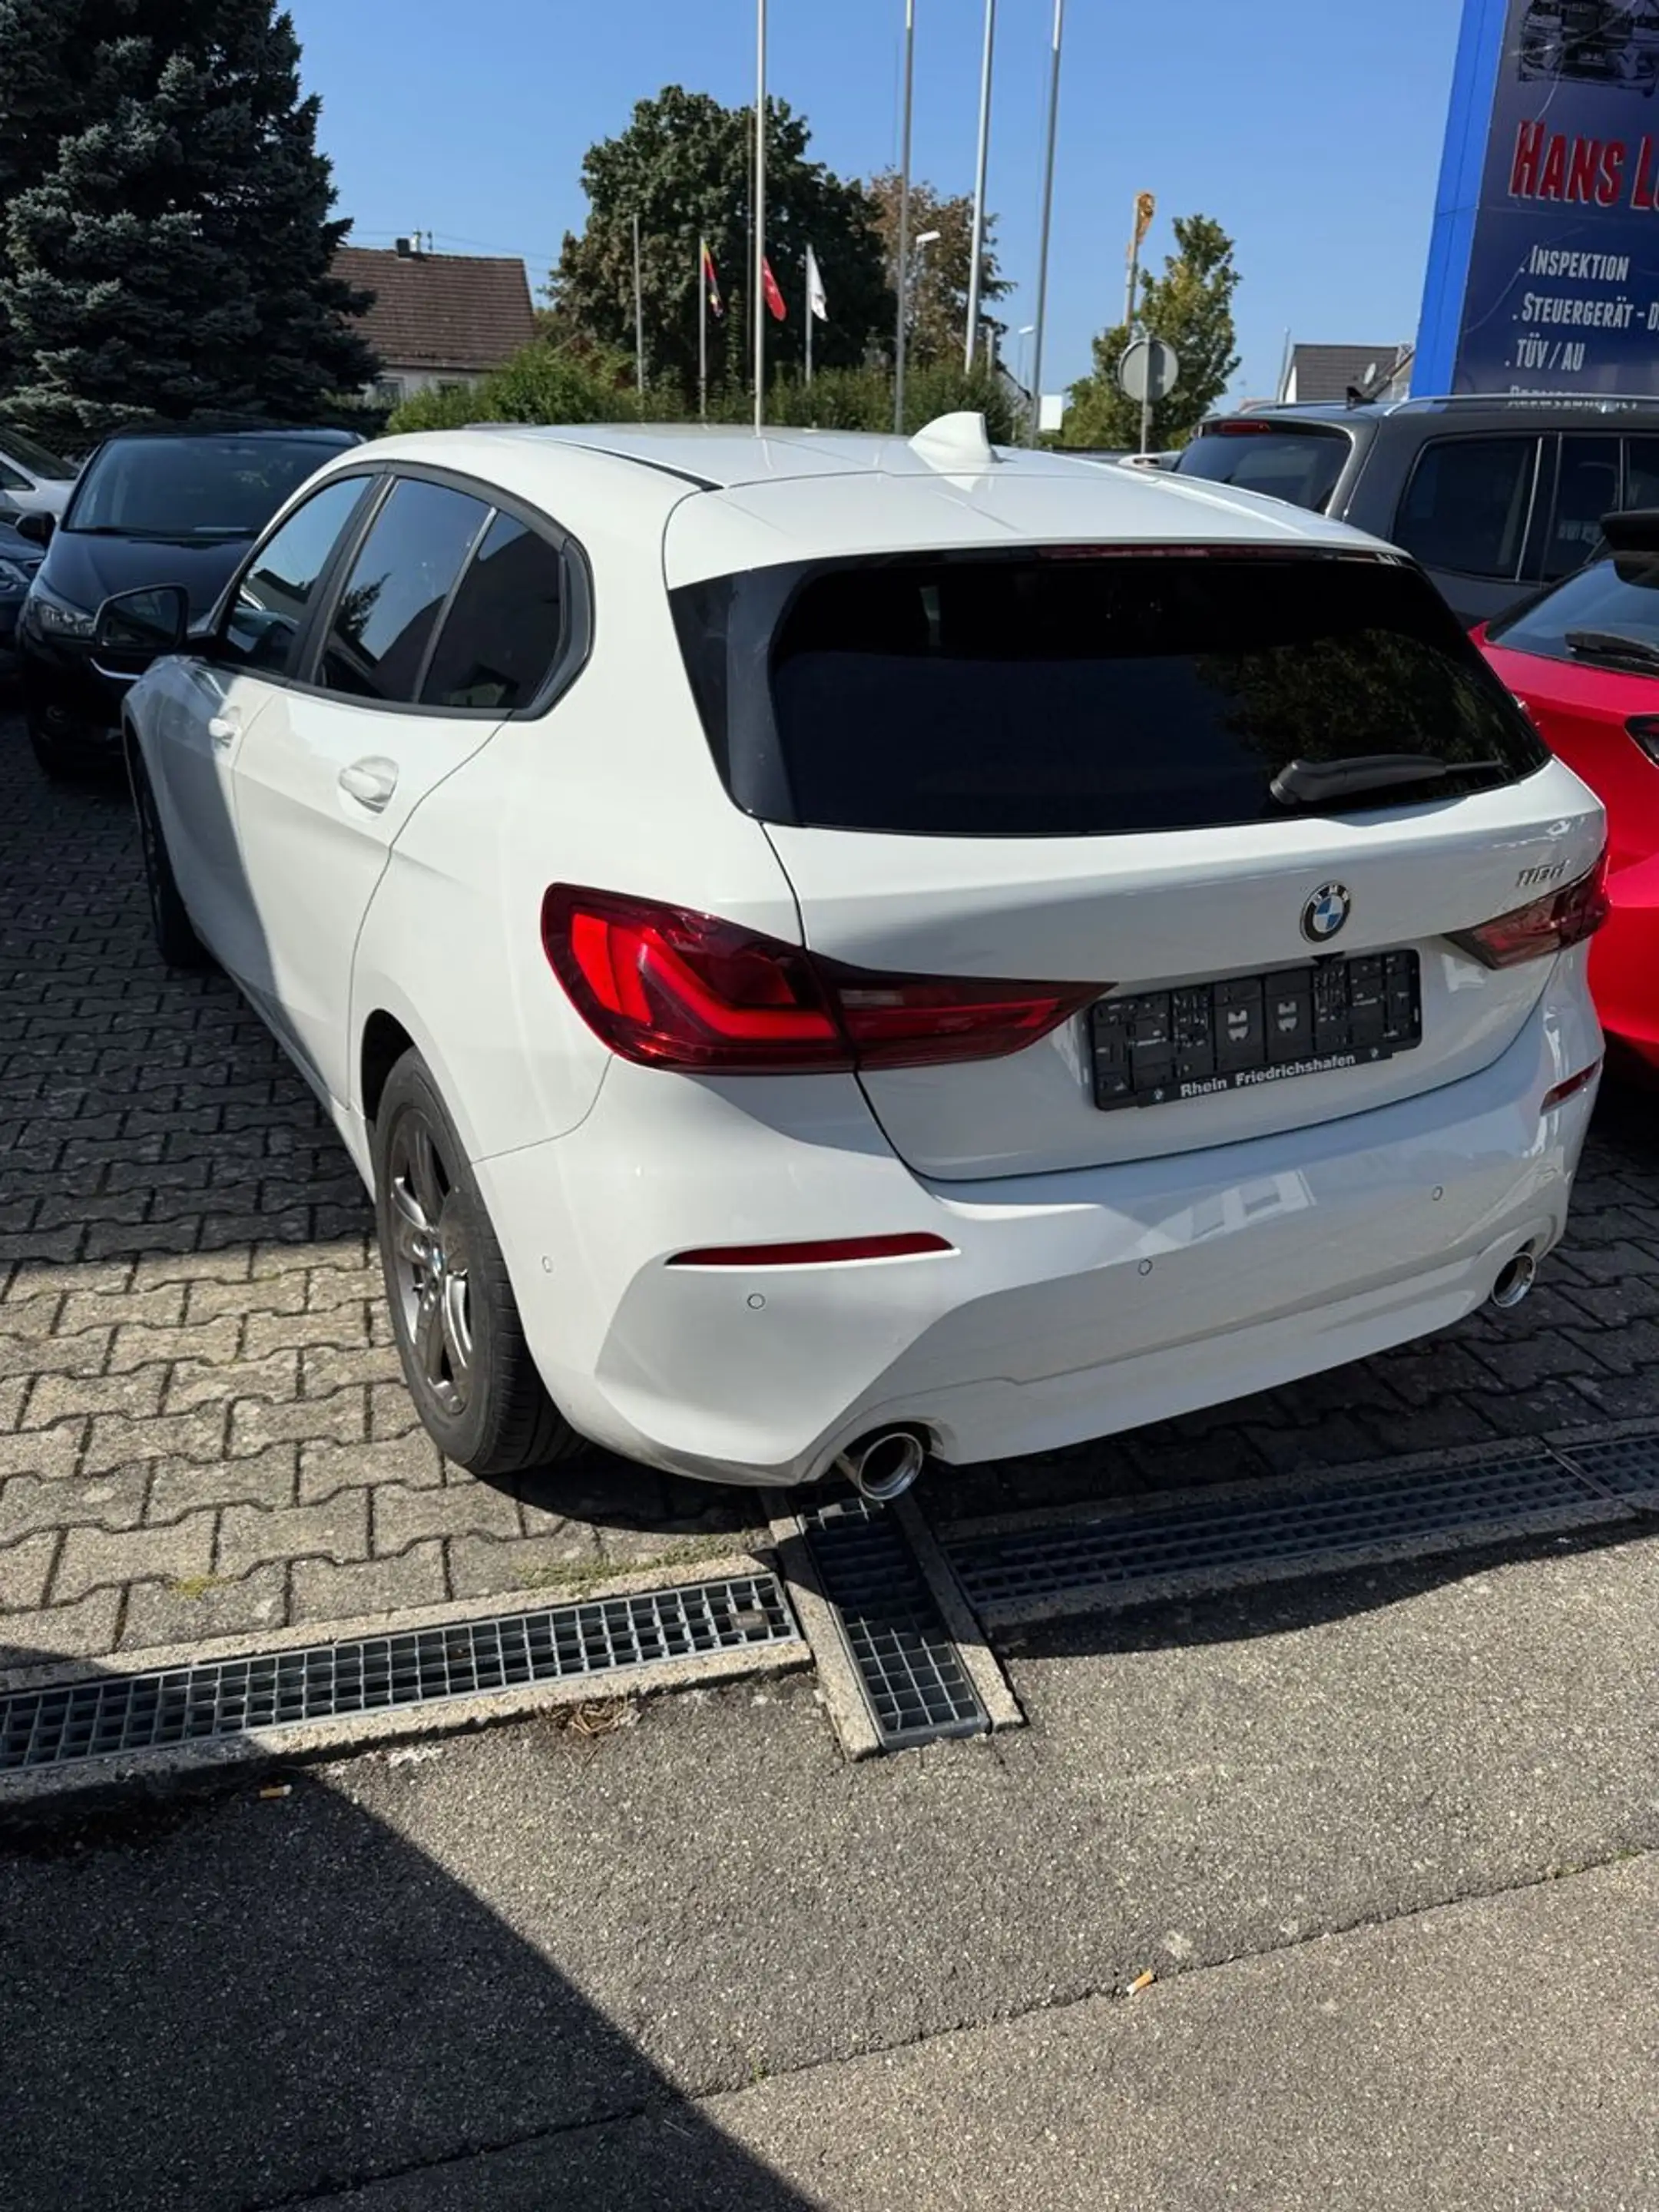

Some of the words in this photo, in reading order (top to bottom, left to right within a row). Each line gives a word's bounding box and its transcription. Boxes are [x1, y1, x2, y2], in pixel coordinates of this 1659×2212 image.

[1508, 120, 1627, 207] HANS
[1528, 245, 1631, 282] INSPEKTION
[1521, 292, 1634, 329] STEUERGERÄT
[1647, 302, 1659, 330] D
[1181, 1078, 1228, 1098] Rhein
[1235, 1054, 1356, 1086] Friedrichshafen
